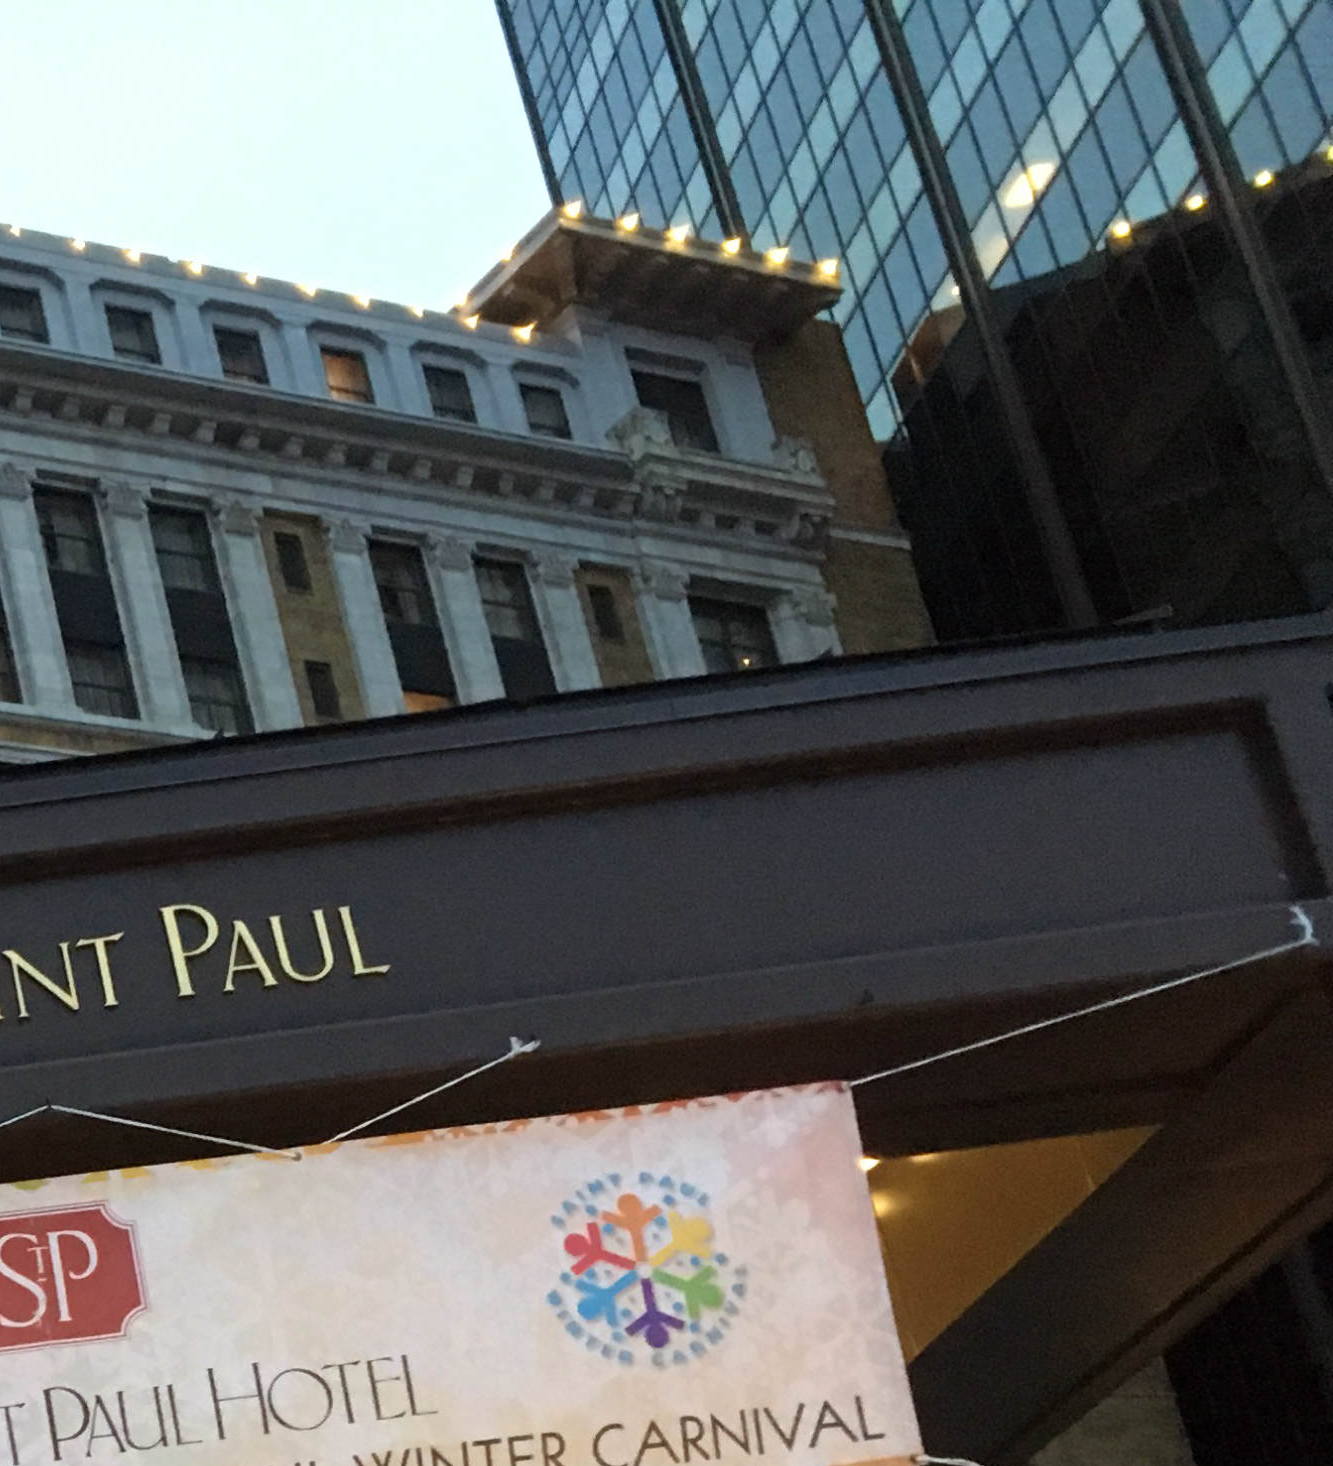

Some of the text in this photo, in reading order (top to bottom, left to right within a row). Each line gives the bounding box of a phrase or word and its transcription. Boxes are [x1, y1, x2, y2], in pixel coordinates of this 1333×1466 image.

[160, 904, 392, 999] PAUL
[42, 1383, 204, 1461] PAUL
[206, 1354, 439, 1440] HOTEL
